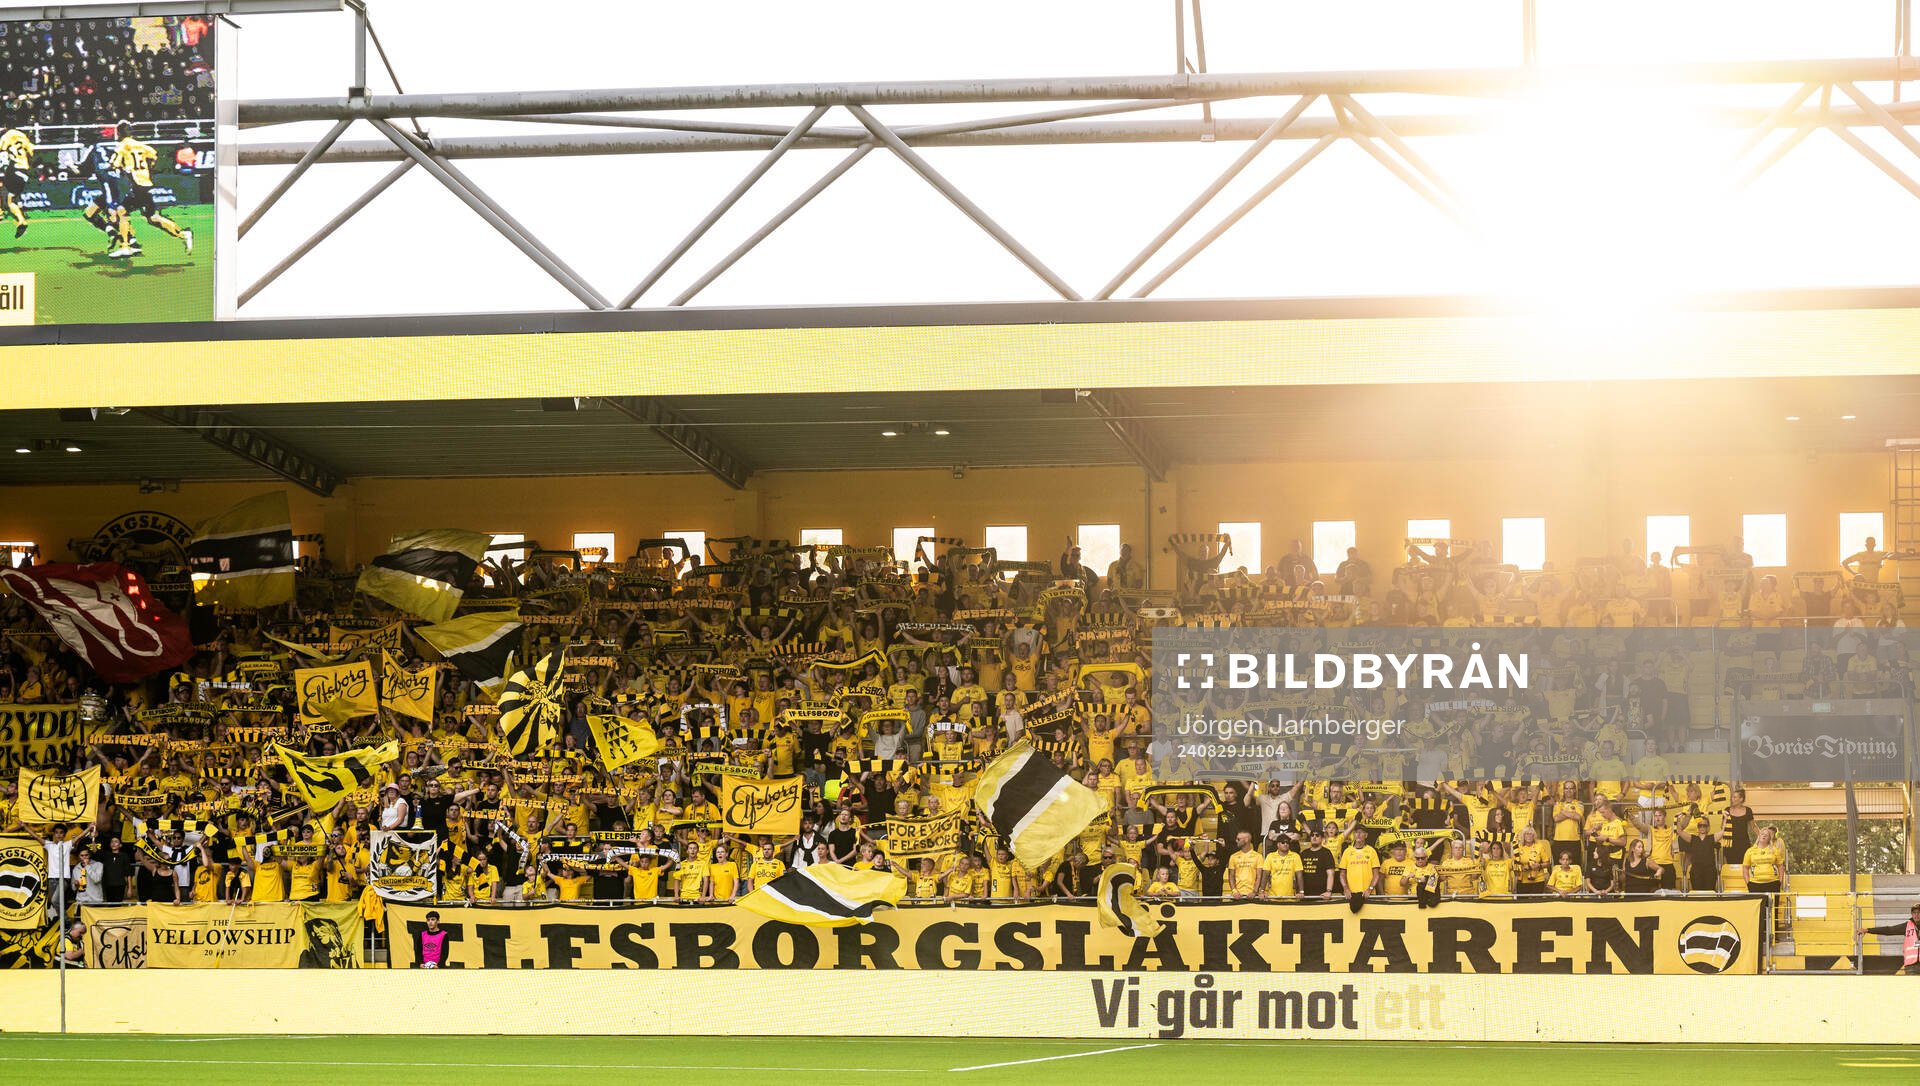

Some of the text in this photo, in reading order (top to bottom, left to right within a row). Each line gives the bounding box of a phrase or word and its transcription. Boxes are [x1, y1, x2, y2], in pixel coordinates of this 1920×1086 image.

[798, 711, 840, 719] ELFSBORG
[1748, 735, 1899, 759] Borås Tidning
[713, 767, 759, 778] ELFSBORG
[127, 796, 164, 805] ELFSBORG
[726, 784, 800, 830] Elfsborg
[919, 816, 960, 836] EVIGT
[1363, 818, 1393, 827] LFSBORG
[889, 833, 960, 850] IF ELFSBORG
[152, 928, 296, 945] YELLOWSHIP
[1091, 974, 1446, 1039] Vi går mot ett
